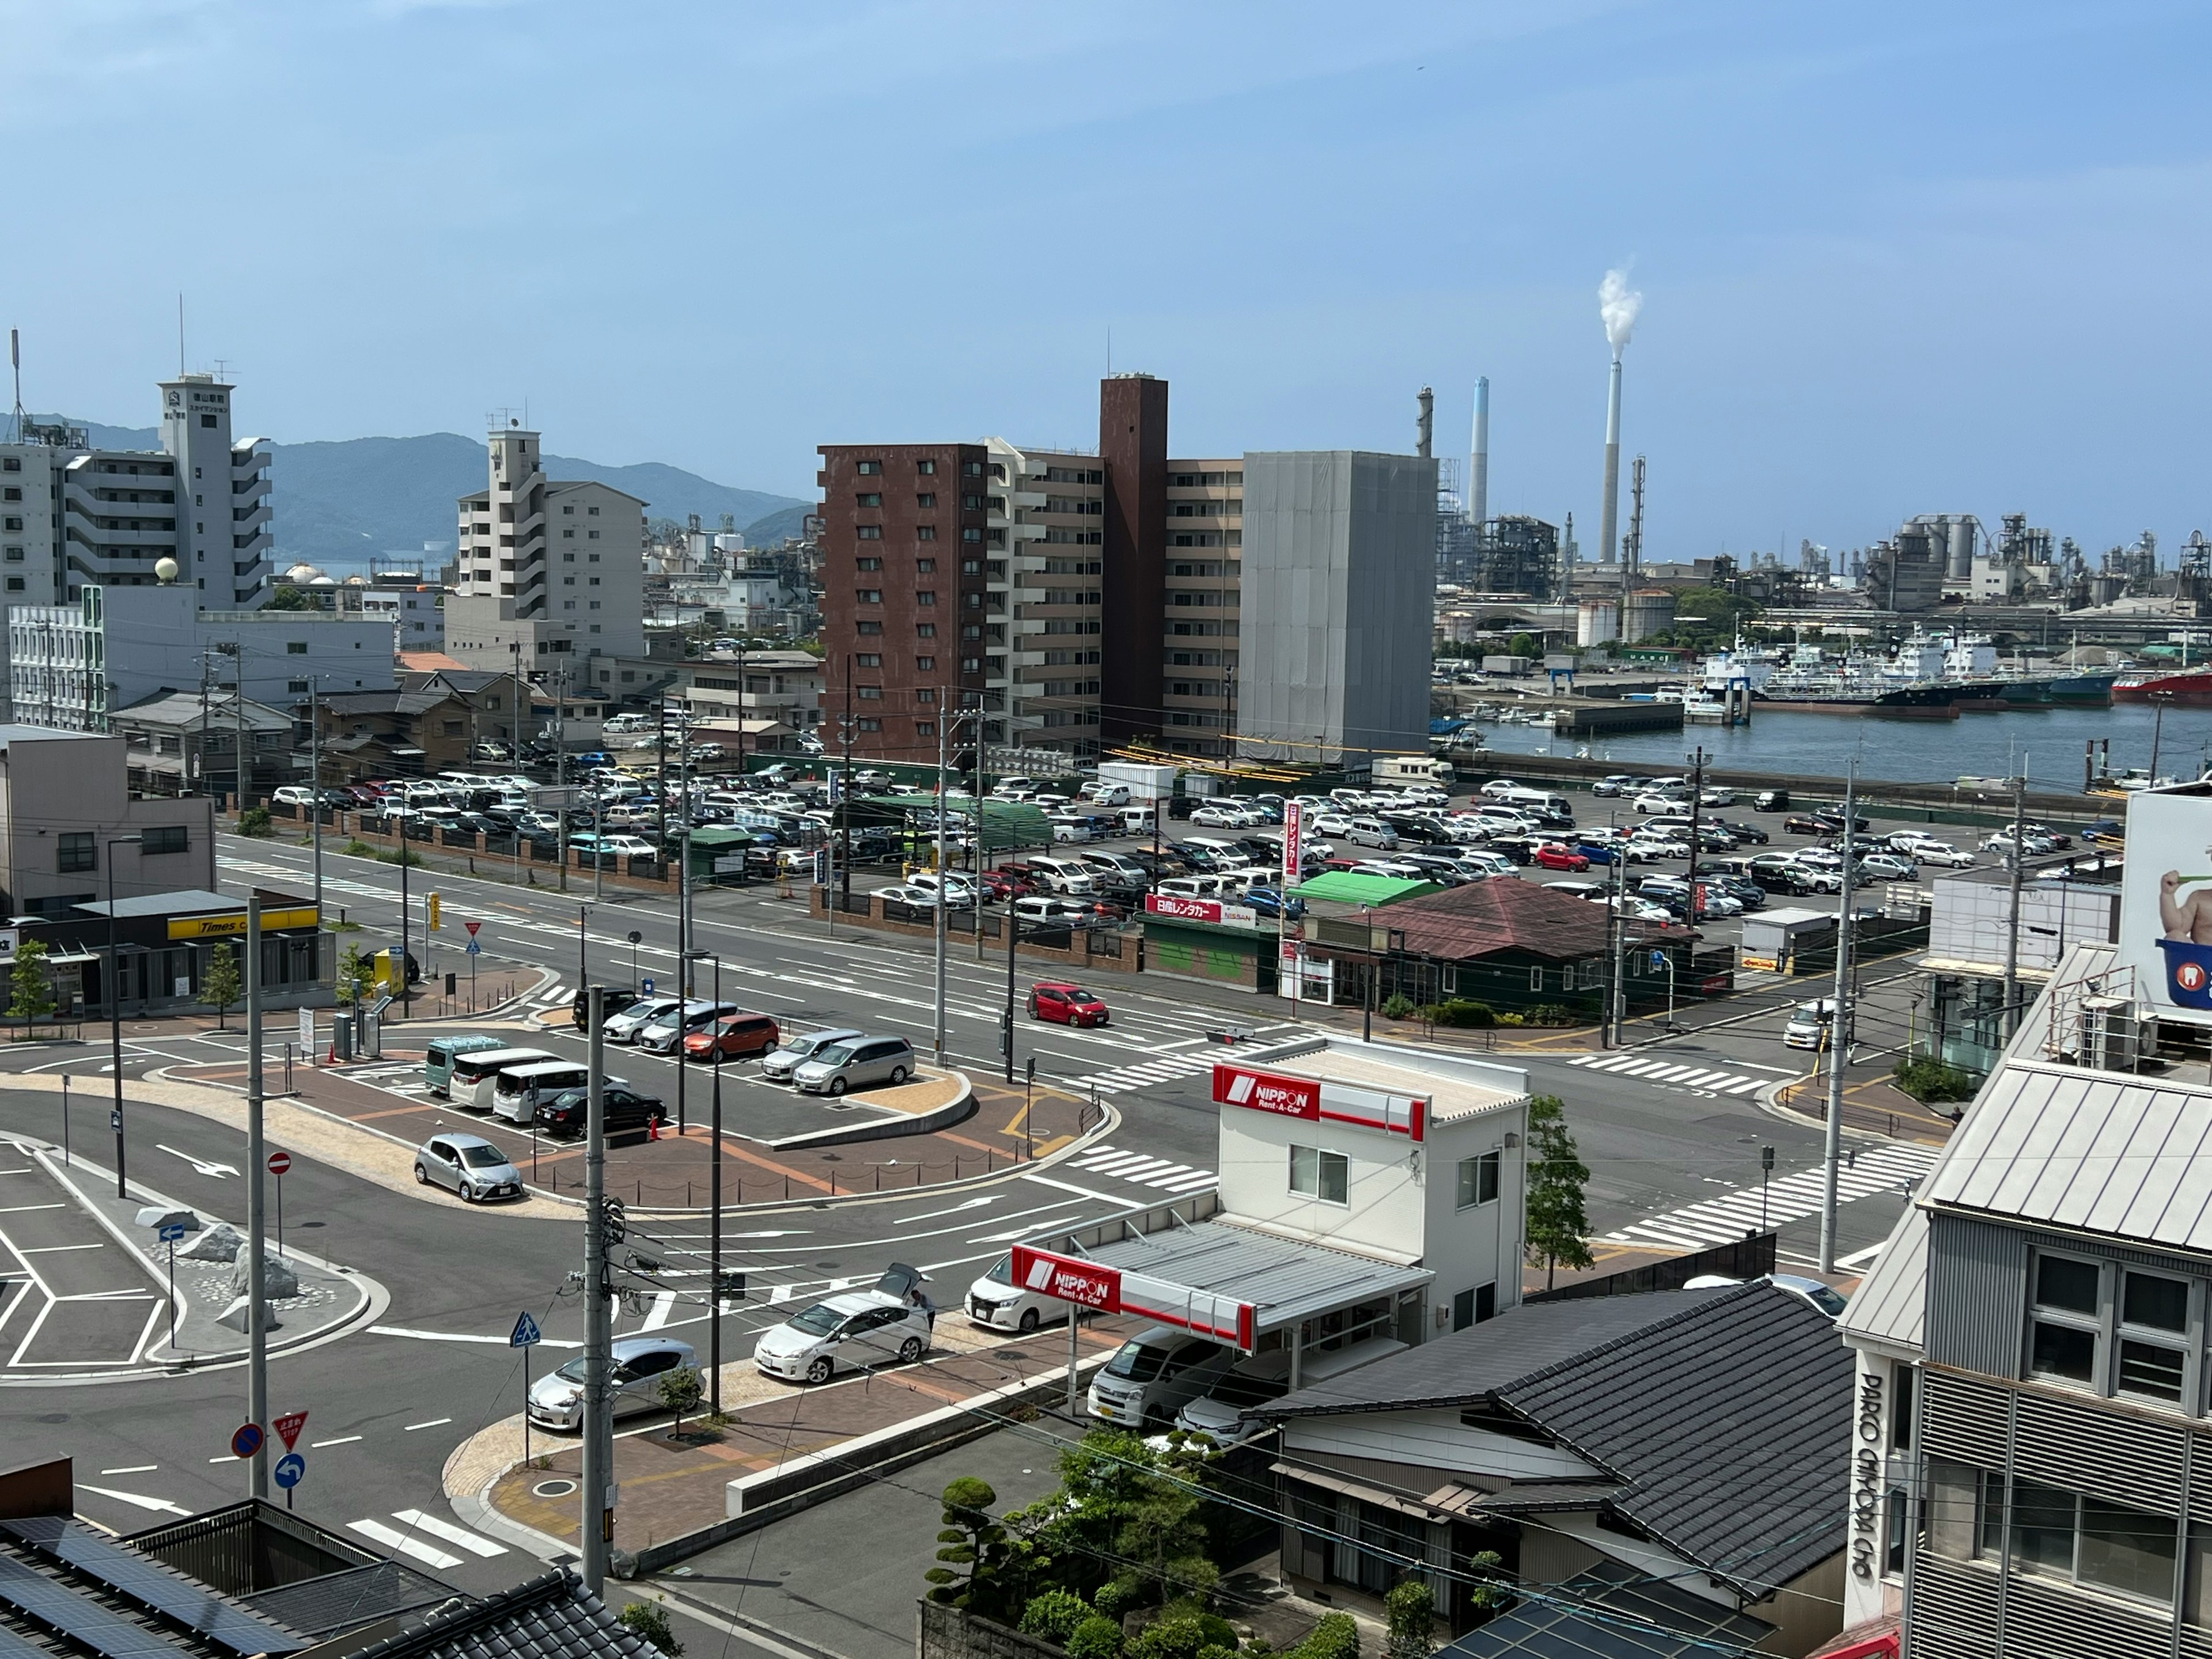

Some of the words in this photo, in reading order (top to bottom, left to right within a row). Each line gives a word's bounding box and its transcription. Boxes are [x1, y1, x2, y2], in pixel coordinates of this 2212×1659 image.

[1287, 806, 1297, 864] 日産レンタカー
[1157, 899, 1210, 918] 日産レンタカー
[1224, 912, 1251, 921] NISSAN
[201, 922, 236, 933] Times
[1255, 1085, 1308, 1107] NIPPON
[1055, 1272, 1108, 1298] NIPPON
[1859, 1373, 1883, 1441] PARCO
[279, 1418, 301, 1431] 止まれ
[283, 1427, 298, 1438] STOP
[1854, 1448, 1878, 1532] CHIYODA
